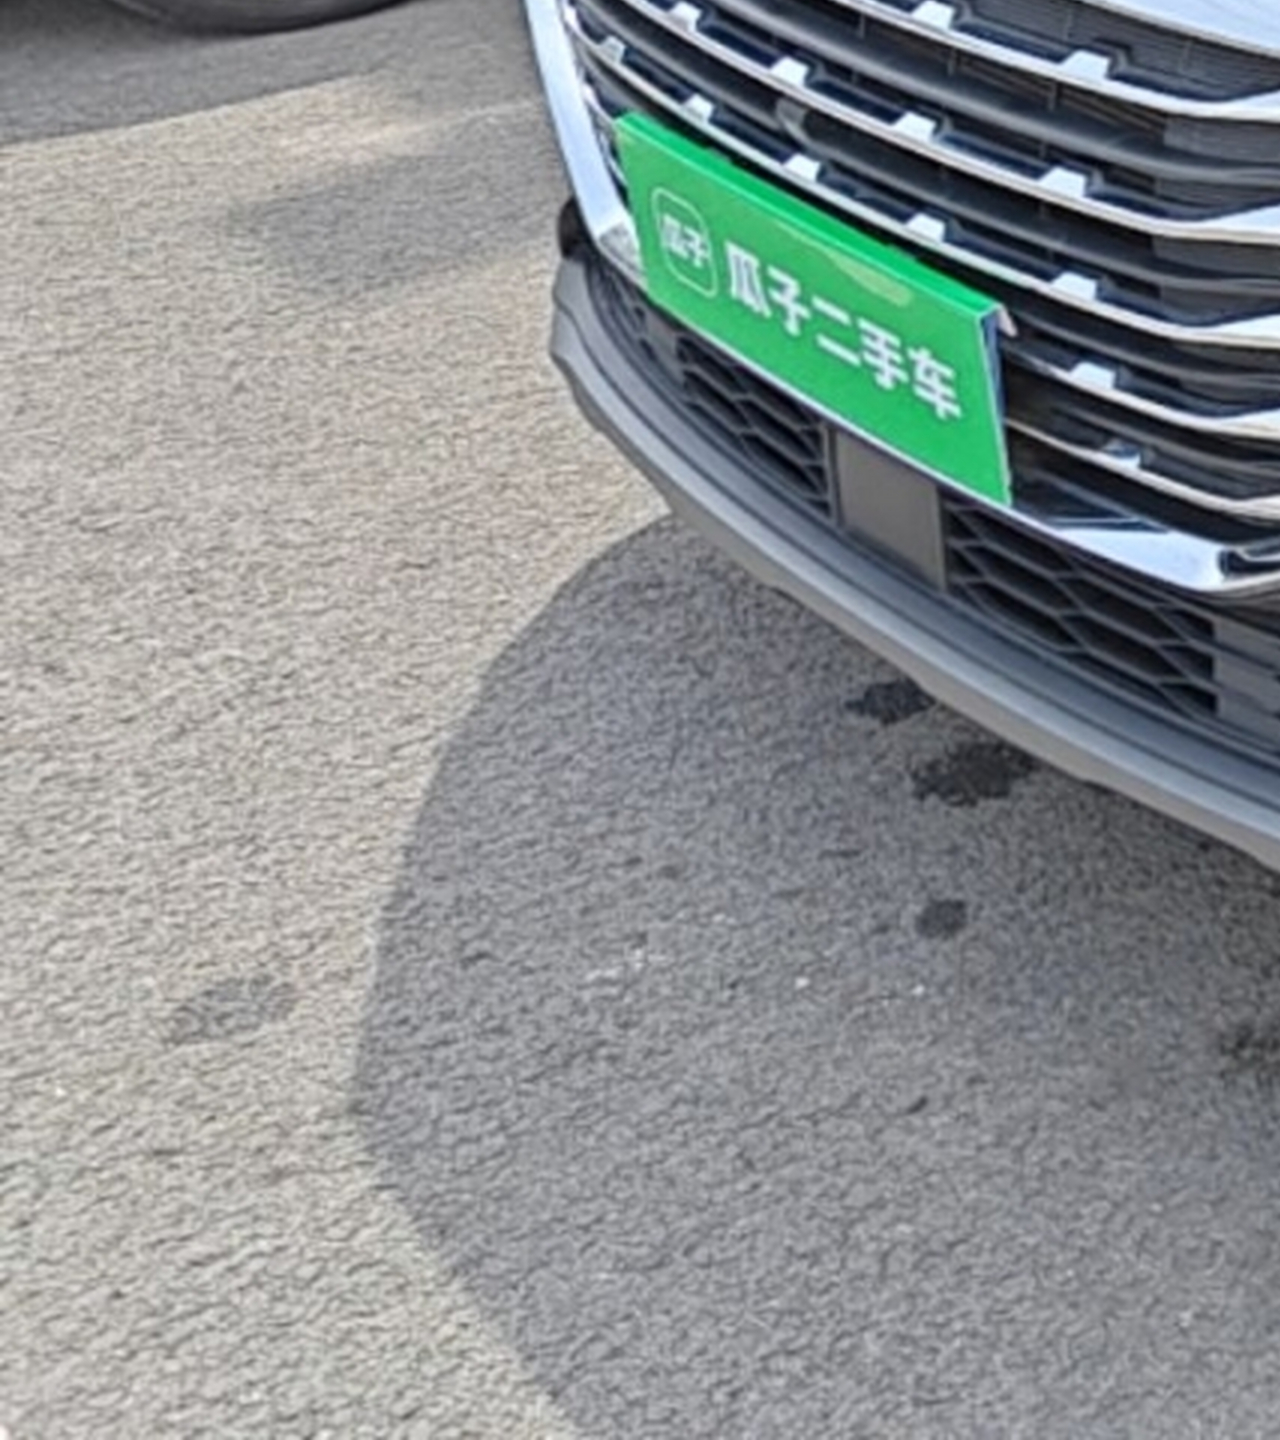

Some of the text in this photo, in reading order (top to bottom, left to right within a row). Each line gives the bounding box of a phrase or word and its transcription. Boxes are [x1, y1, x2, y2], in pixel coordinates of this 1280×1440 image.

[725, 239, 962, 420] 瓜子二手车
